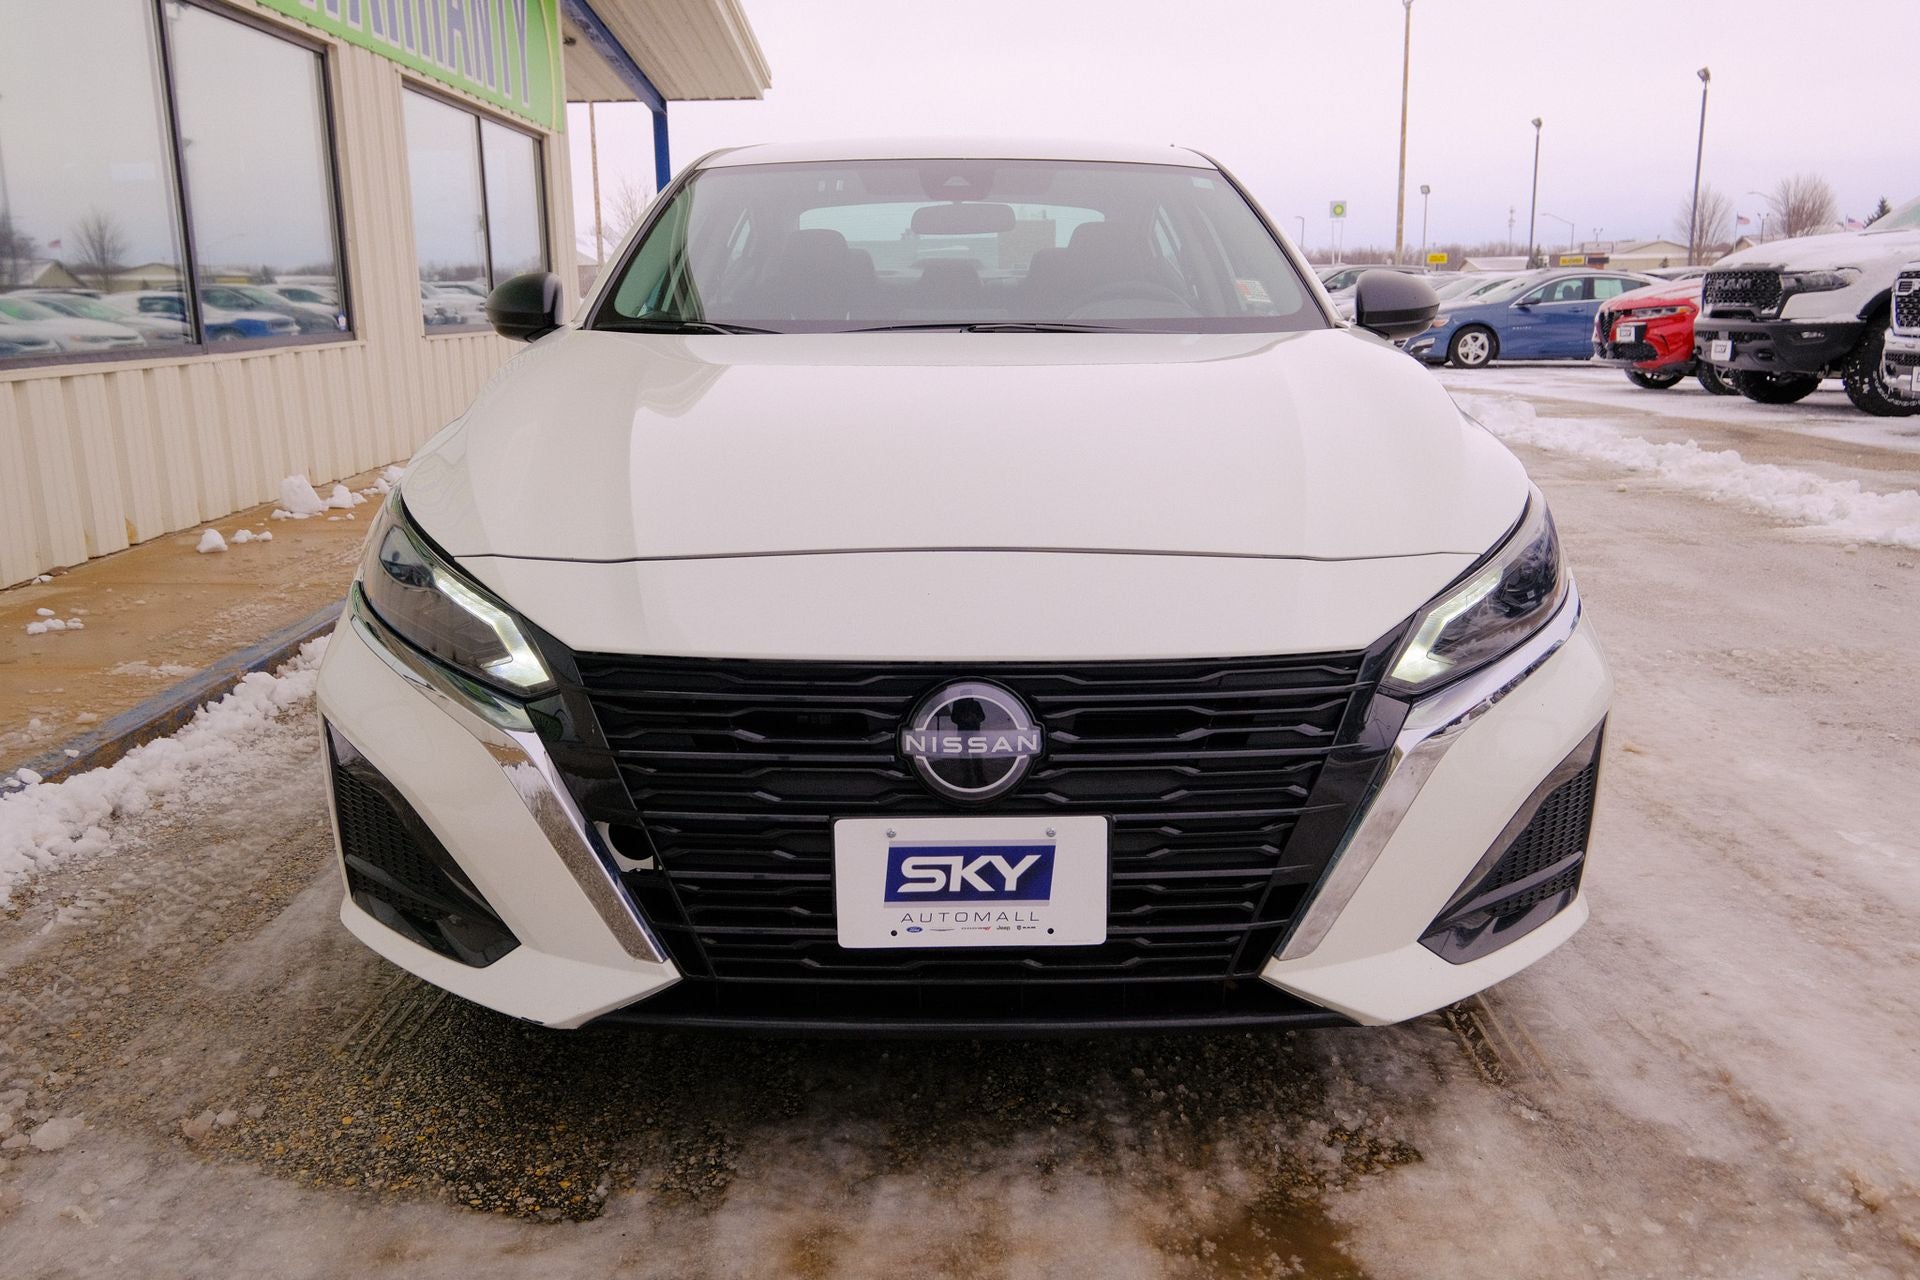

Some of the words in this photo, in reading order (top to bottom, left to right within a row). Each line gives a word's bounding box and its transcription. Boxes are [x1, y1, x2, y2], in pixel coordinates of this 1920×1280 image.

[1715, 278, 1751, 290] RAM
[905, 734, 1037, 753] NISSAN
[896, 854, 1042, 893] SKY
[900, 911, 1040, 923] AUTOMALL
